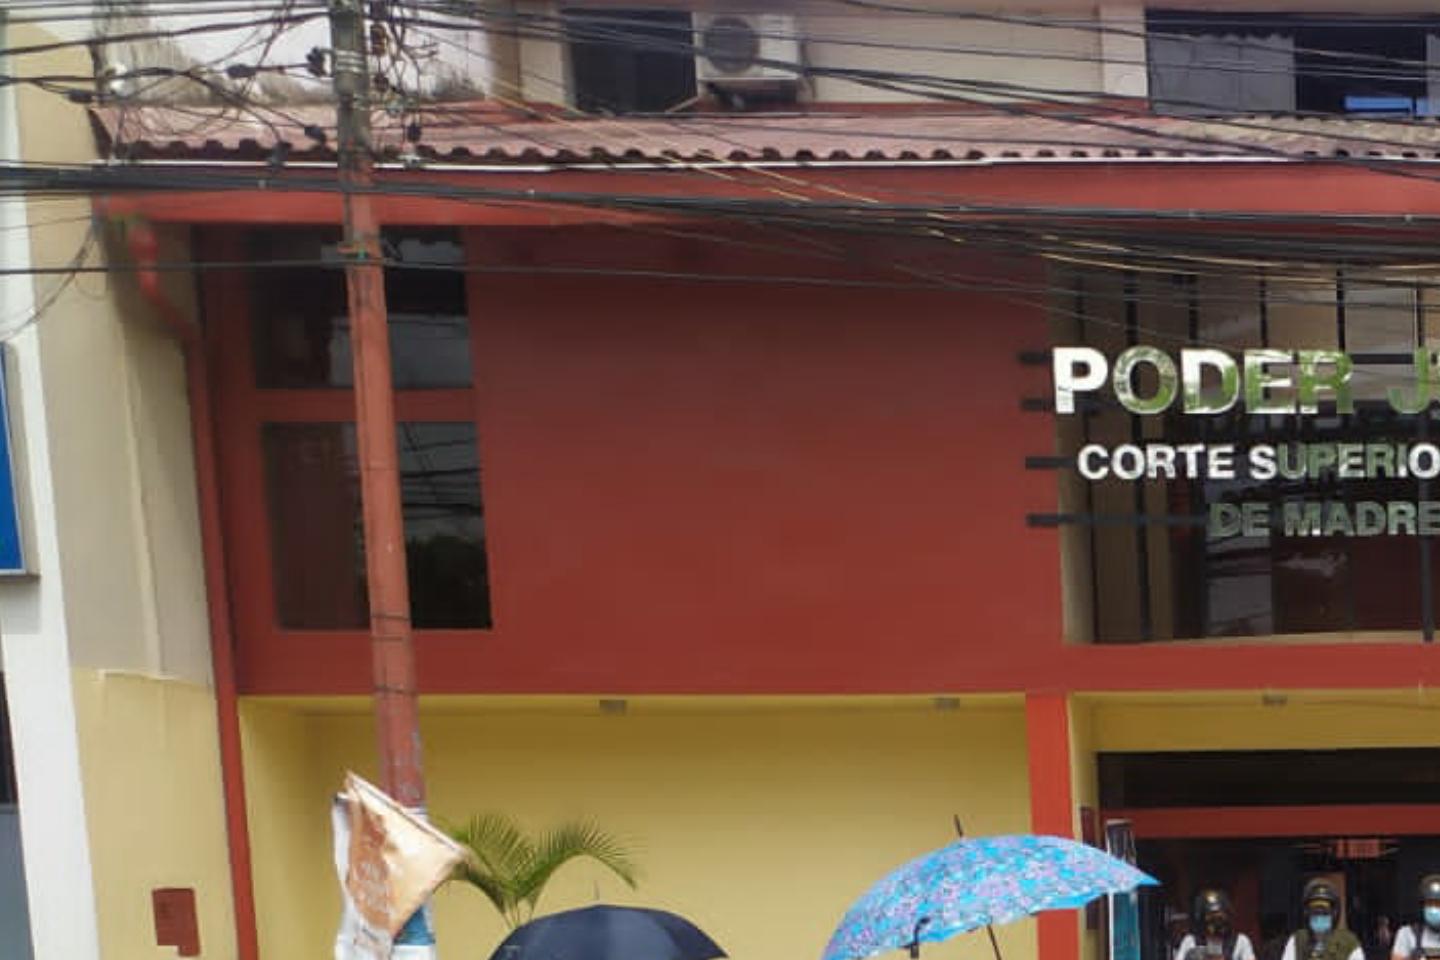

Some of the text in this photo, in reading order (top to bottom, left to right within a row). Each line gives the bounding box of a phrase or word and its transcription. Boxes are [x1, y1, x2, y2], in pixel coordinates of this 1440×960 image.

[1053, 346, 1353, 414] PODER
[1078, 444, 1236, 480] CORTE
[1209, 502, 1271, 537] DE
